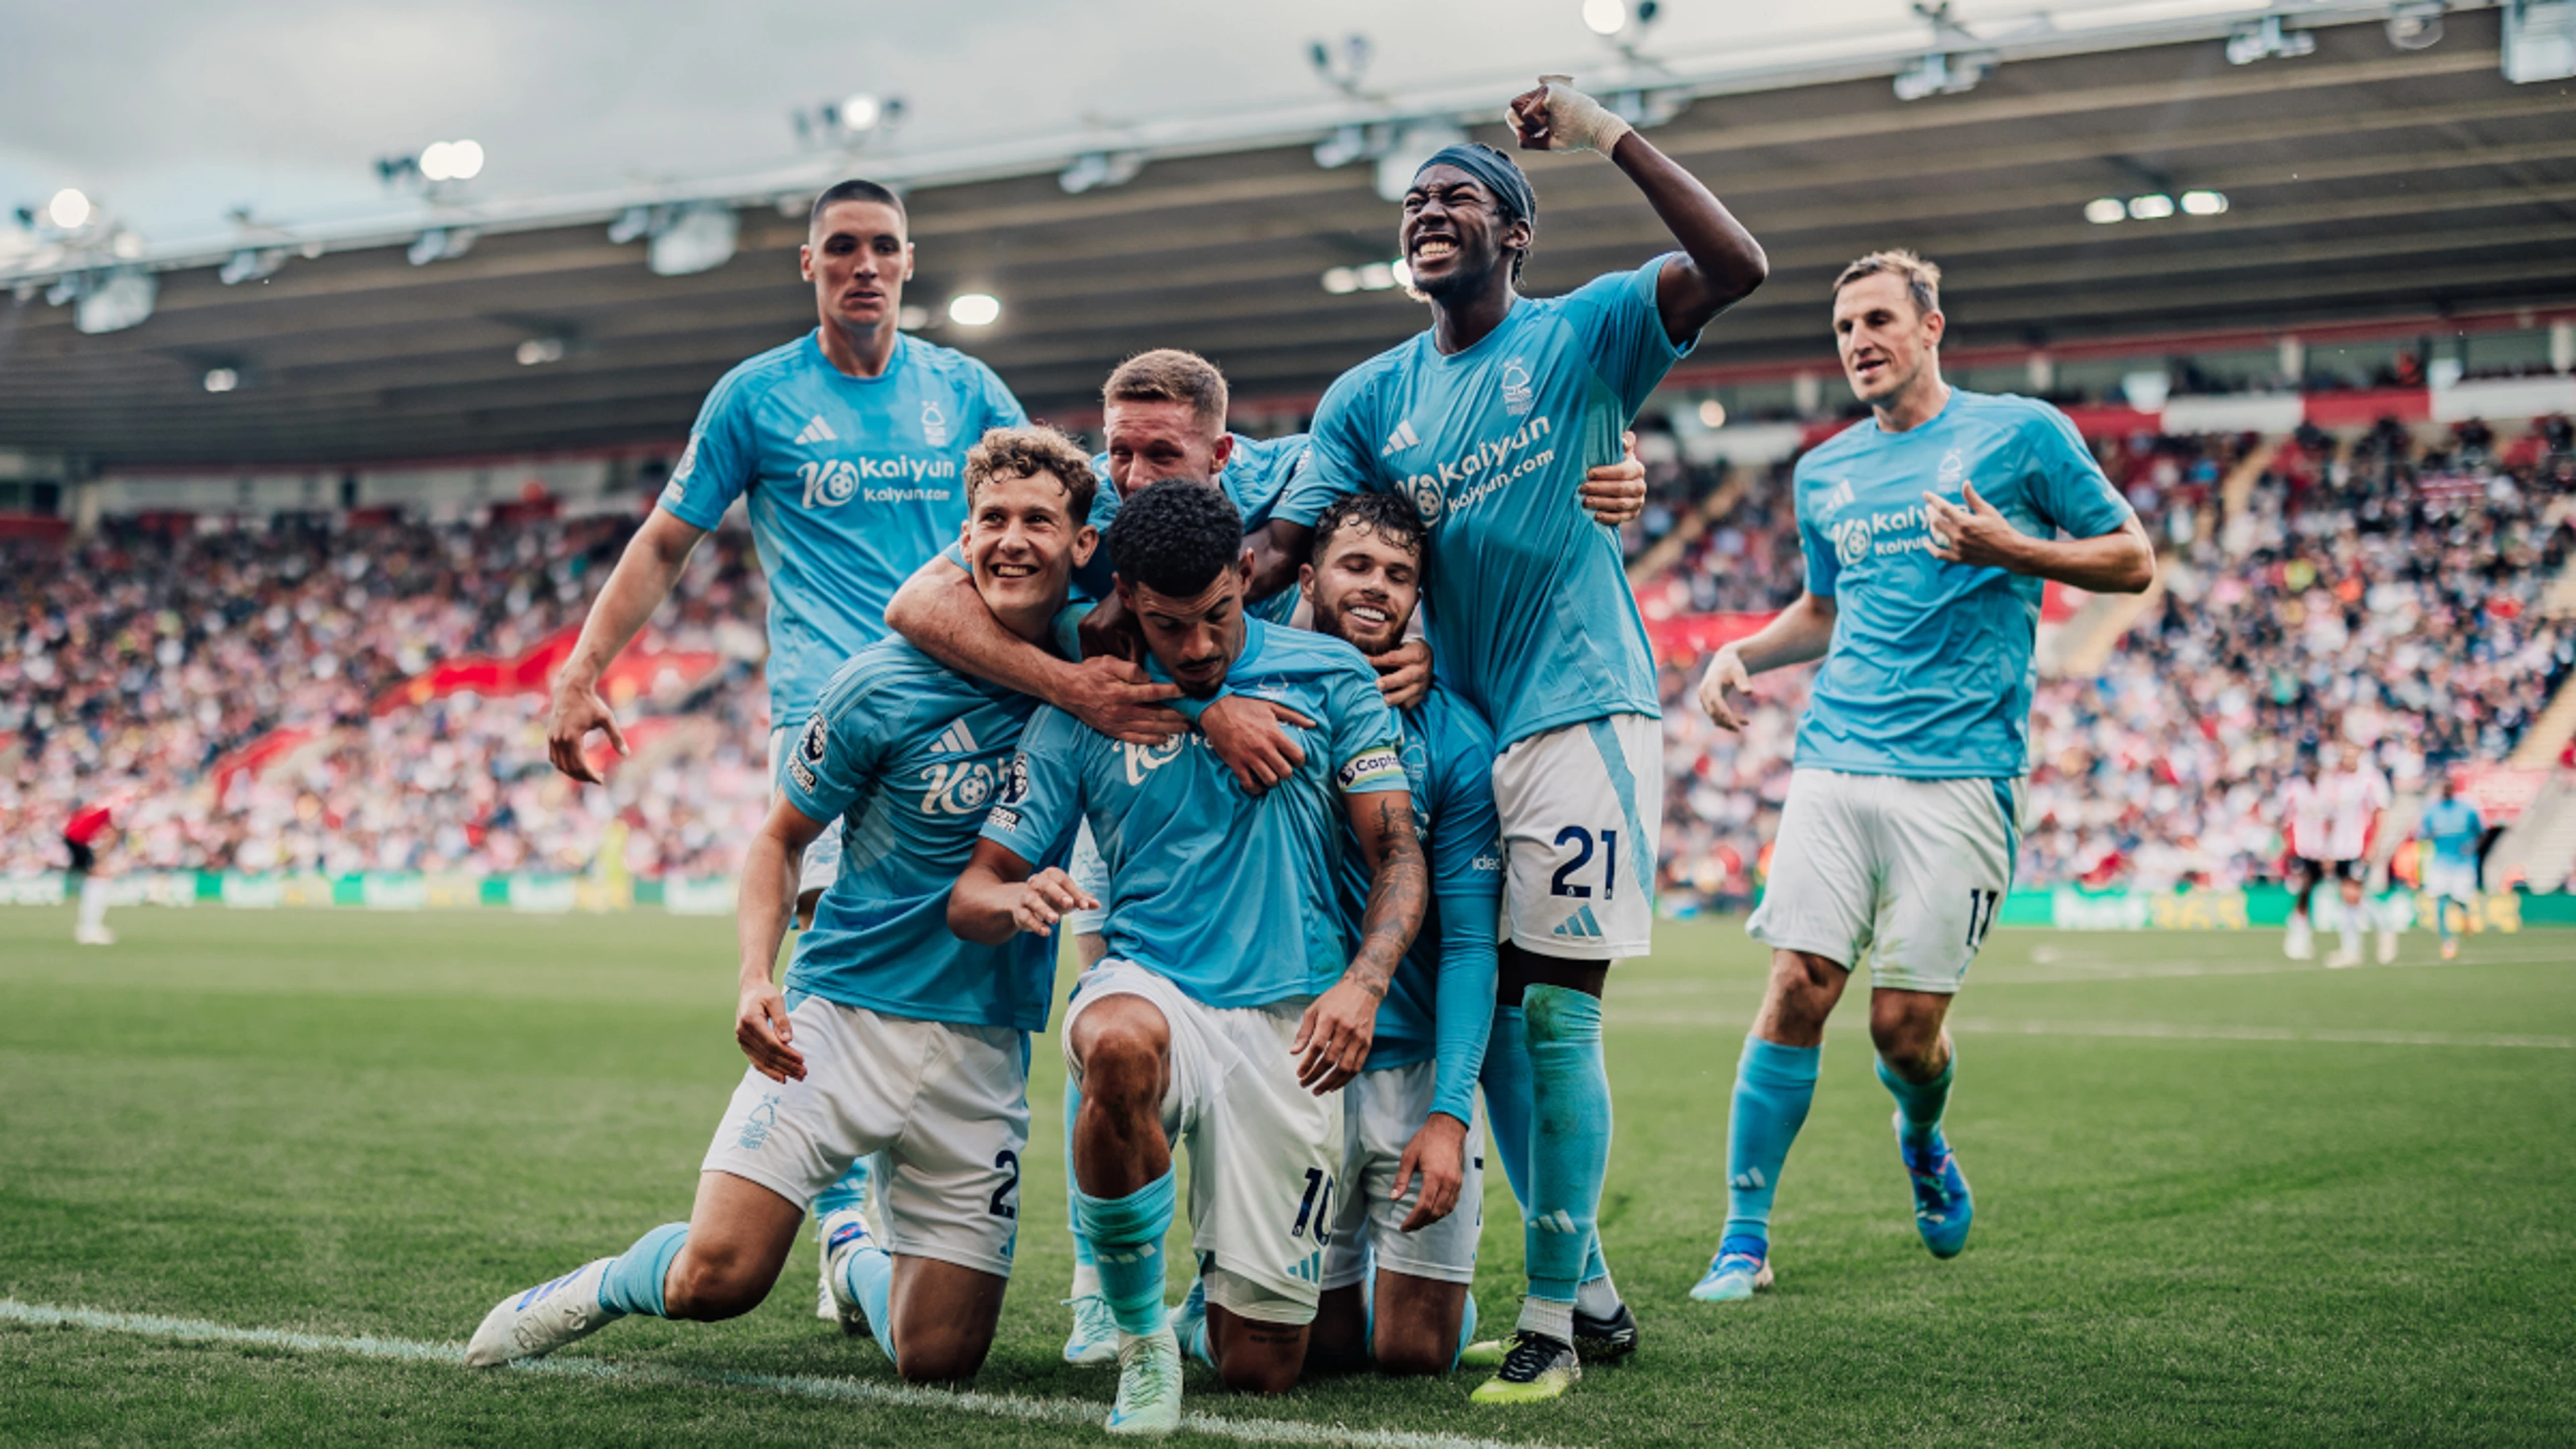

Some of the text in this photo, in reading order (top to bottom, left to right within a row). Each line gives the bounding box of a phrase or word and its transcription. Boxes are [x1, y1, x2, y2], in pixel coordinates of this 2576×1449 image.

[863, 486, 951, 503] kaiyun.com
[1447, 449, 1555, 514] kaiyun.com
[1550, 824, 1617, 900] 21
[1966, 888, 1998, 947] 11
